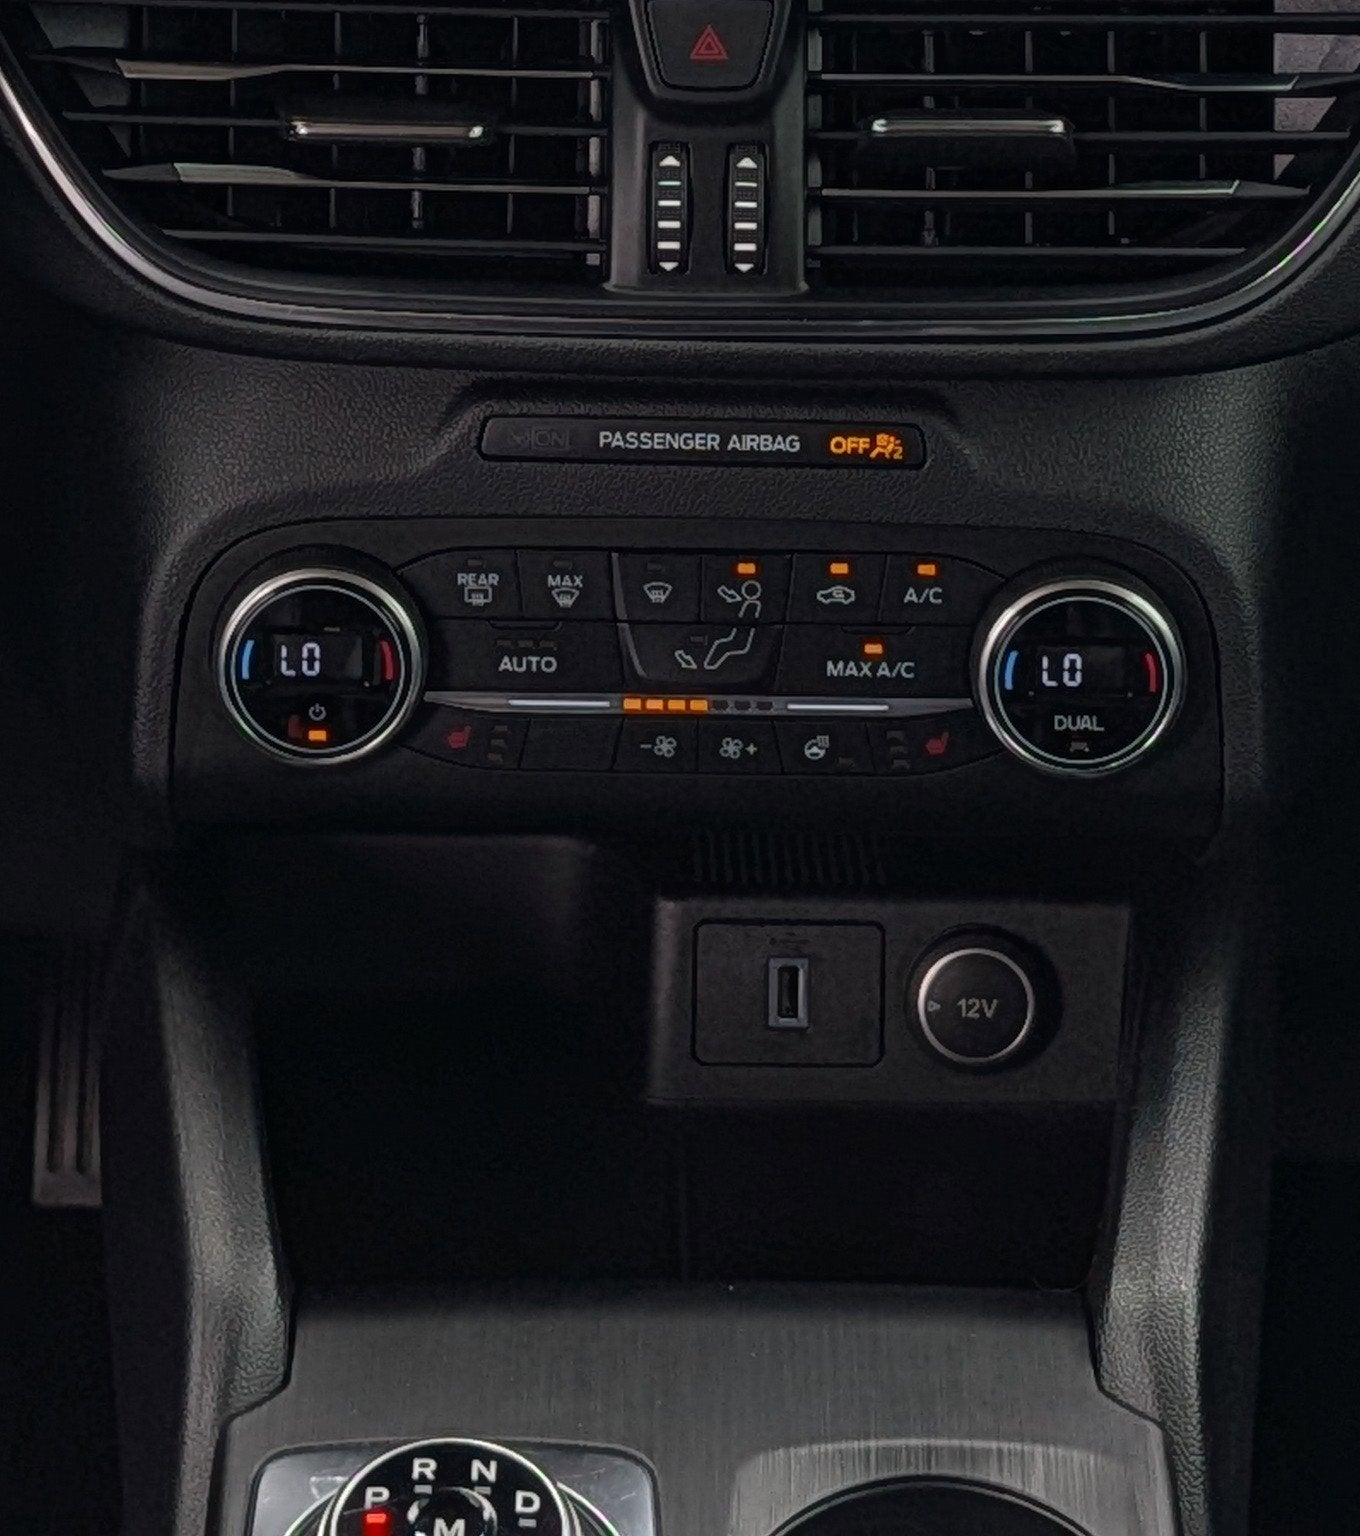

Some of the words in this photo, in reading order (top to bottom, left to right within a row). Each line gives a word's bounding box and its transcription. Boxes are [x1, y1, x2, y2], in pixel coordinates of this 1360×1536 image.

[599, 431, 720, 451] PASSENGER
[727, 433, 801, 453] AIRBAG
[830, 436, 871, 455] OFF
[457, 573, 499, 587] REAR
[547, 575, 583, 588] MAX
[904, 586, 943, 605] A/C
[498, 656, 558, 673] AUTO
[826, 661, 872, 678] MAX
[876, 660, 915, 679] A/C
[1054, 715, 1105, 732] DUAL
[957, 998, 998, 1020] 12V
[412, 1457, 437, 1481] R
[470, 1459, 497, 1483] N
[365, 1486, 390, 1509] P
[515, 1490, 540, 1514] D
